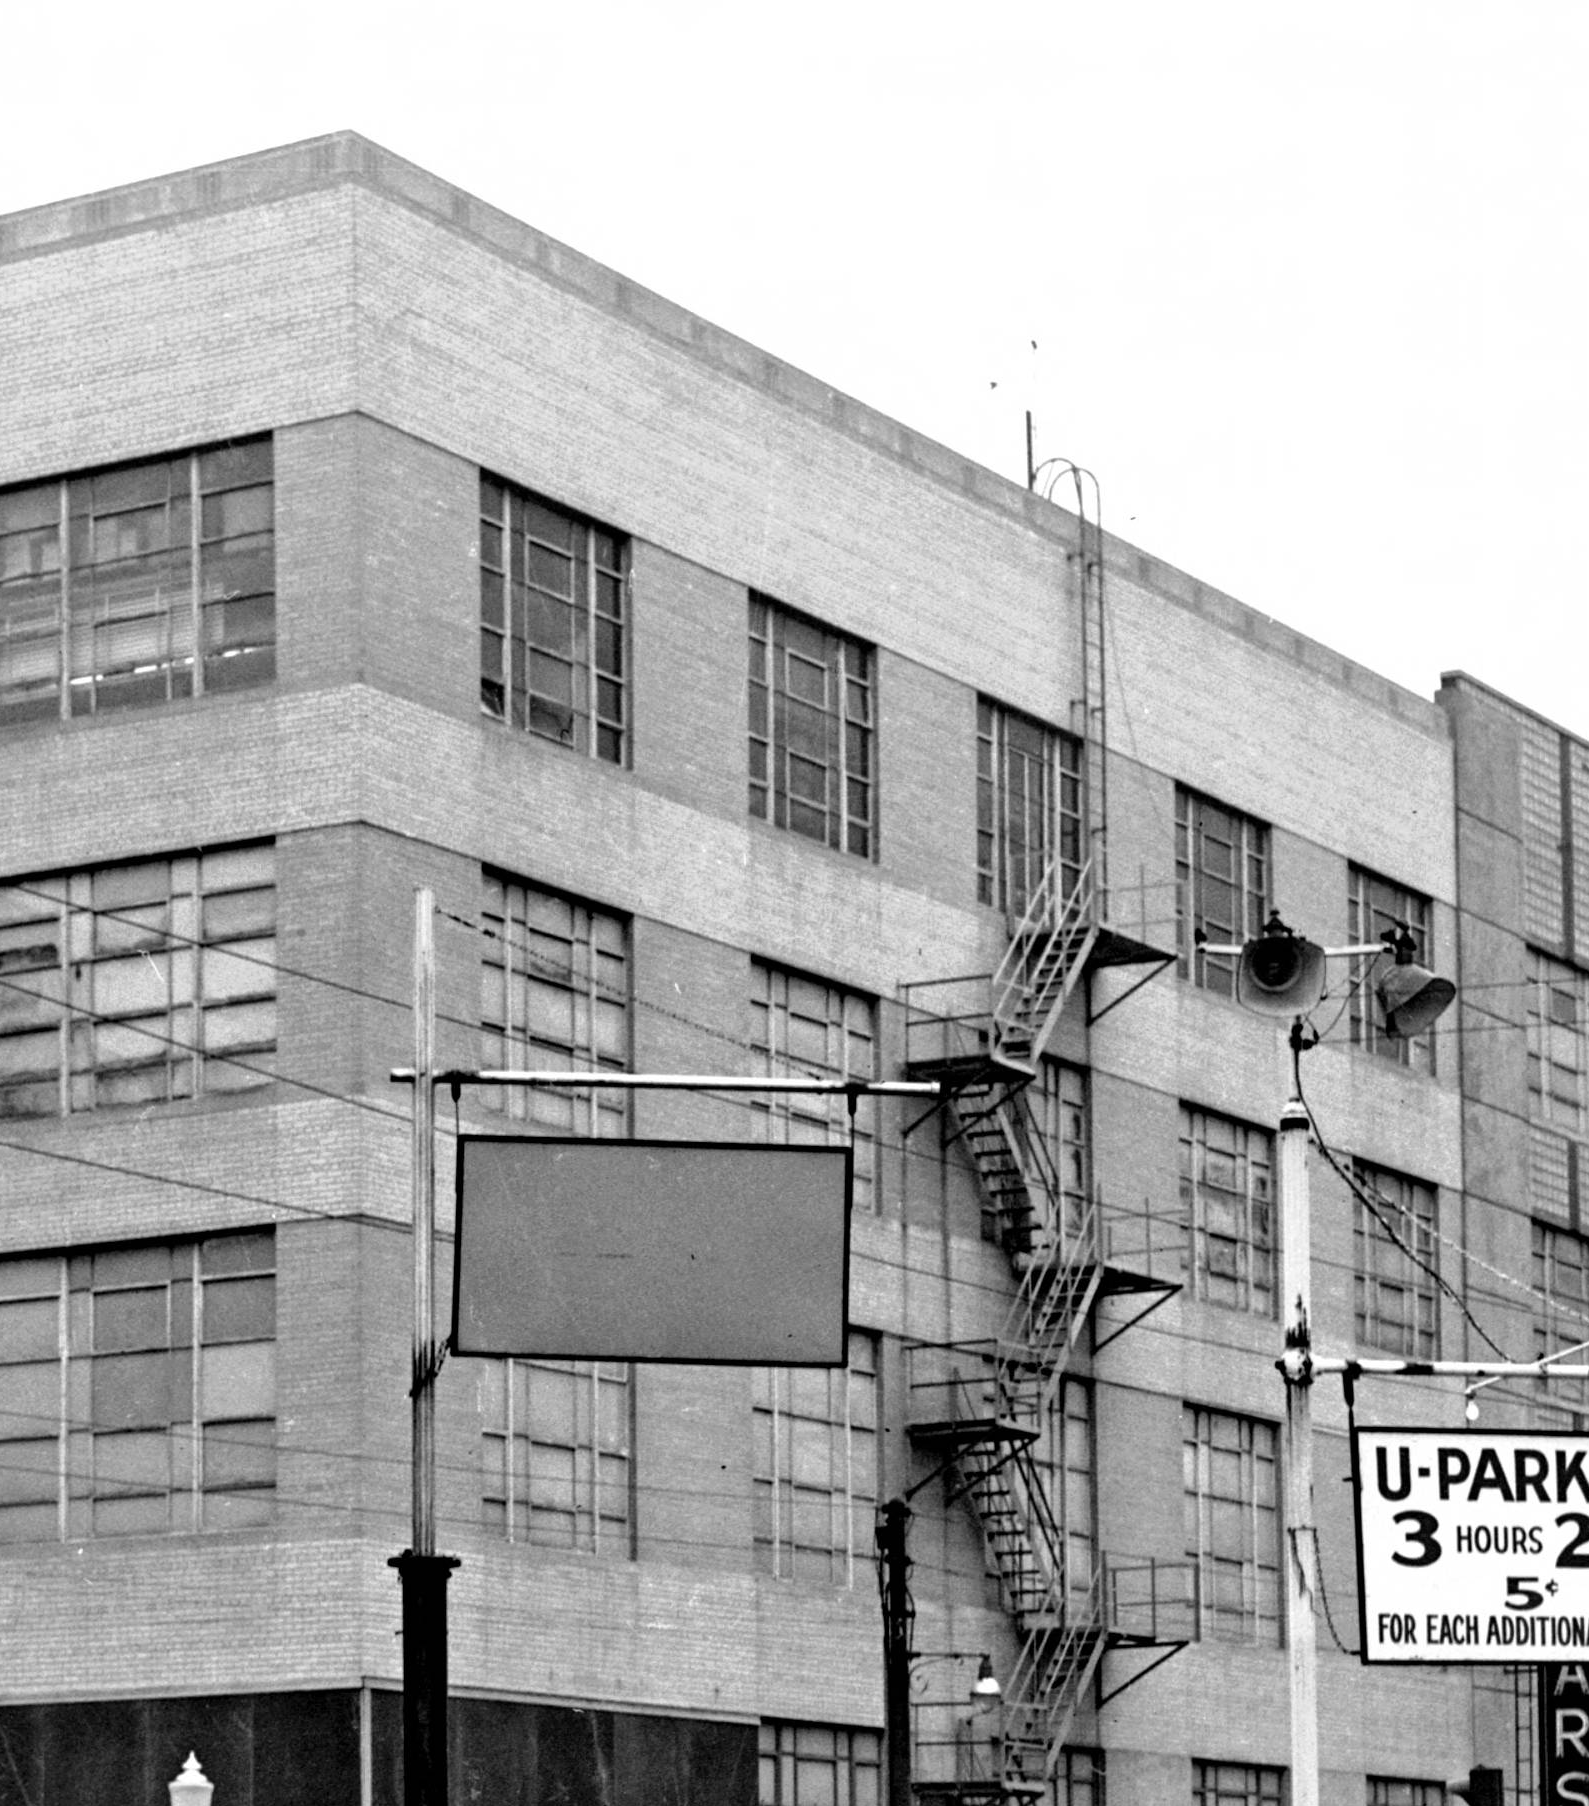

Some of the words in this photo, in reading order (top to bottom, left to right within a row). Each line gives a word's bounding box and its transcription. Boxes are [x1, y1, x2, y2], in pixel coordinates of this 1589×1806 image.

[1390, 1509, 1442, 1568] 3
[1456, 1525, 1544, 1554] HOURS
[1377, 1612, 1418, 1644] FOR
[1426, 1613, 1480, 1645] EACH
